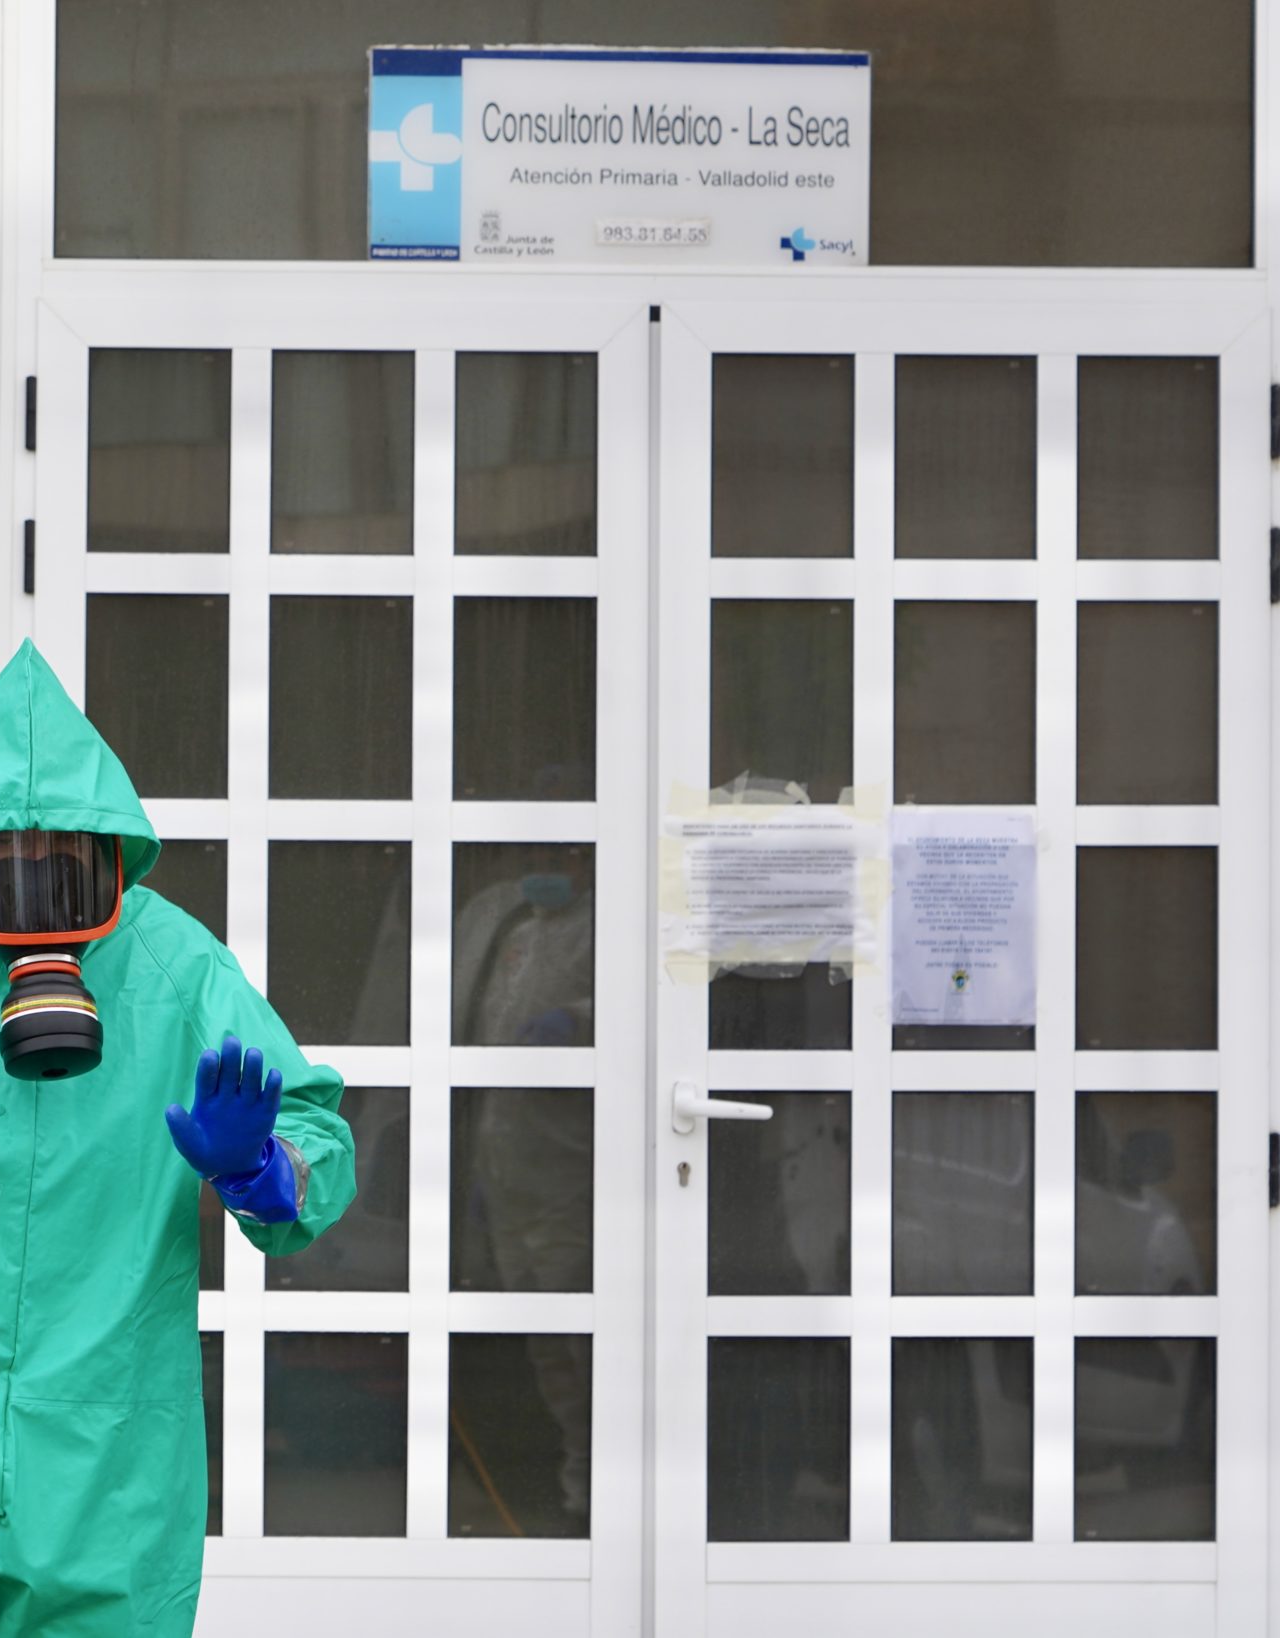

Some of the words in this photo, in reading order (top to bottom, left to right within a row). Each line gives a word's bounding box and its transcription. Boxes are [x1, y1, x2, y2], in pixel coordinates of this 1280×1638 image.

[482, 102, 623, 145] Consultorio
[632, 103, 722, 145] Médico
[748, 106, 778, 146] La
[787, 106, 850, 147] Seca
[510, 167, 592, 185] Atención
[600, 168, 678, 186] Primaria
[699, 170, 789, 188] Valladolid
[795, 173, 835, 188] este
[506, 234, 537, 245] Junta
[540, 235, 554, 245] de
[819, 239, 854, 254] Sacyl
[473, 245, 514, 255] Castilla
[516, 247, 523, 258] y
[527, 246, 555, 256] León
